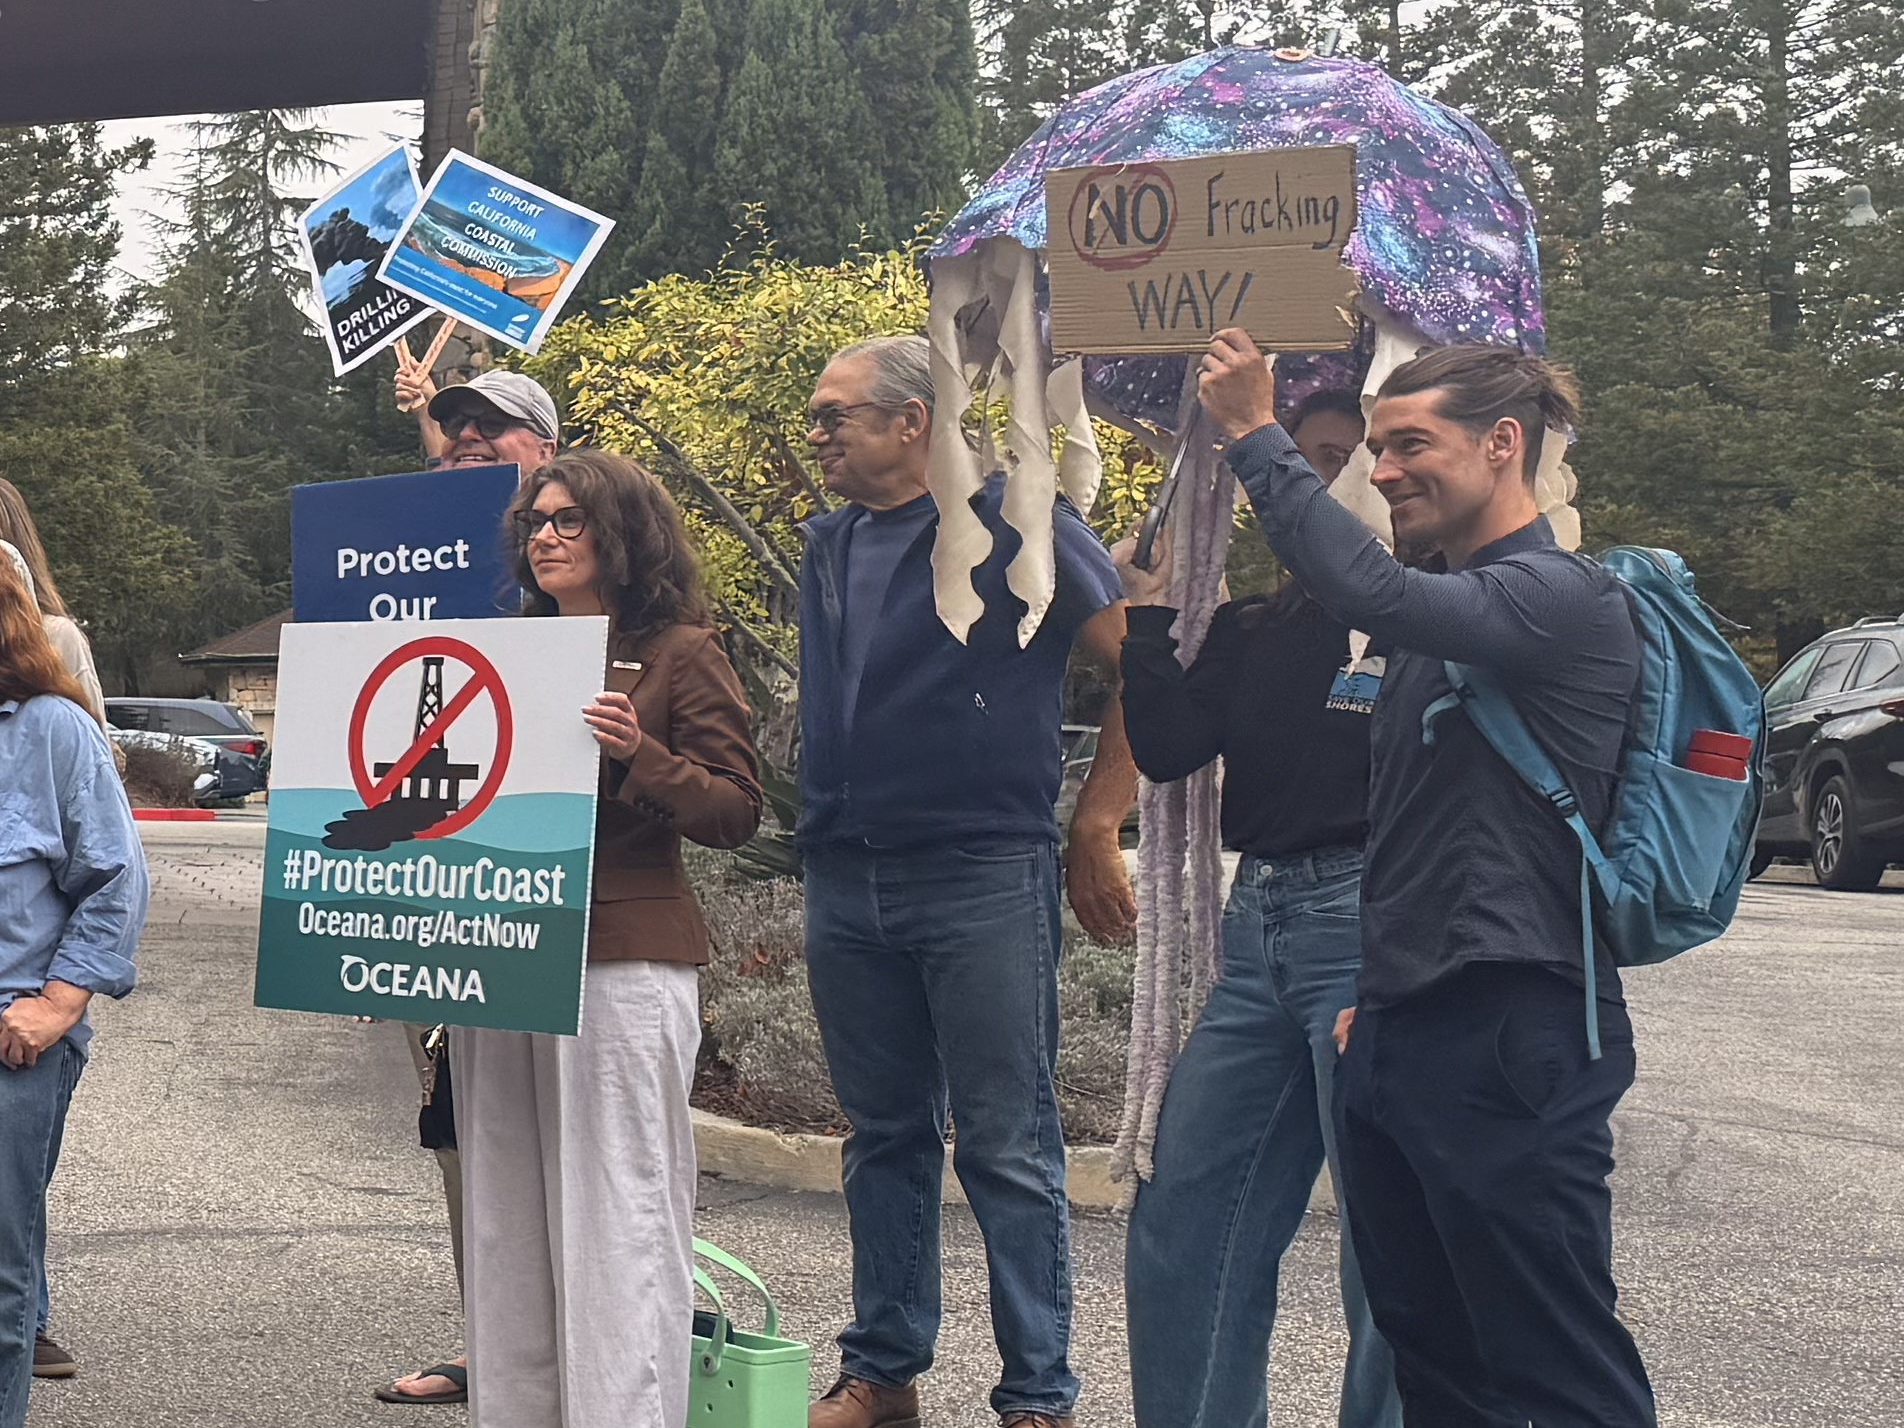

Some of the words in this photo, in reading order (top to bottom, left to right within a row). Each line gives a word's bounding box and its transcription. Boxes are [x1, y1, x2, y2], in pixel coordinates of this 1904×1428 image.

[468, 200, 537, 240] CALIFORNIA
[488, 186, 544, 219] SUPPORT
[1083, 182, 1170, 246] NO
[1206, 171, 1340, 251] Fracking
[440, 235, 517, 279] COMMISSION
[464, 222, 516, 255] COASTAL
[1127, 270, 1255, 332] WAY!
[342, 298, 411, 354] KILLING
[336, 538, 470, 578] Protect
[368, 592, 437, 622] Our
[1325, 700, 1374, 714] SHORES
[283, 848, 566, 906] #ProtectOurCoast
[298, 902, 540, 951] Oceana.org/ActNow
[339, 954, 486, 1004] OCEANA
